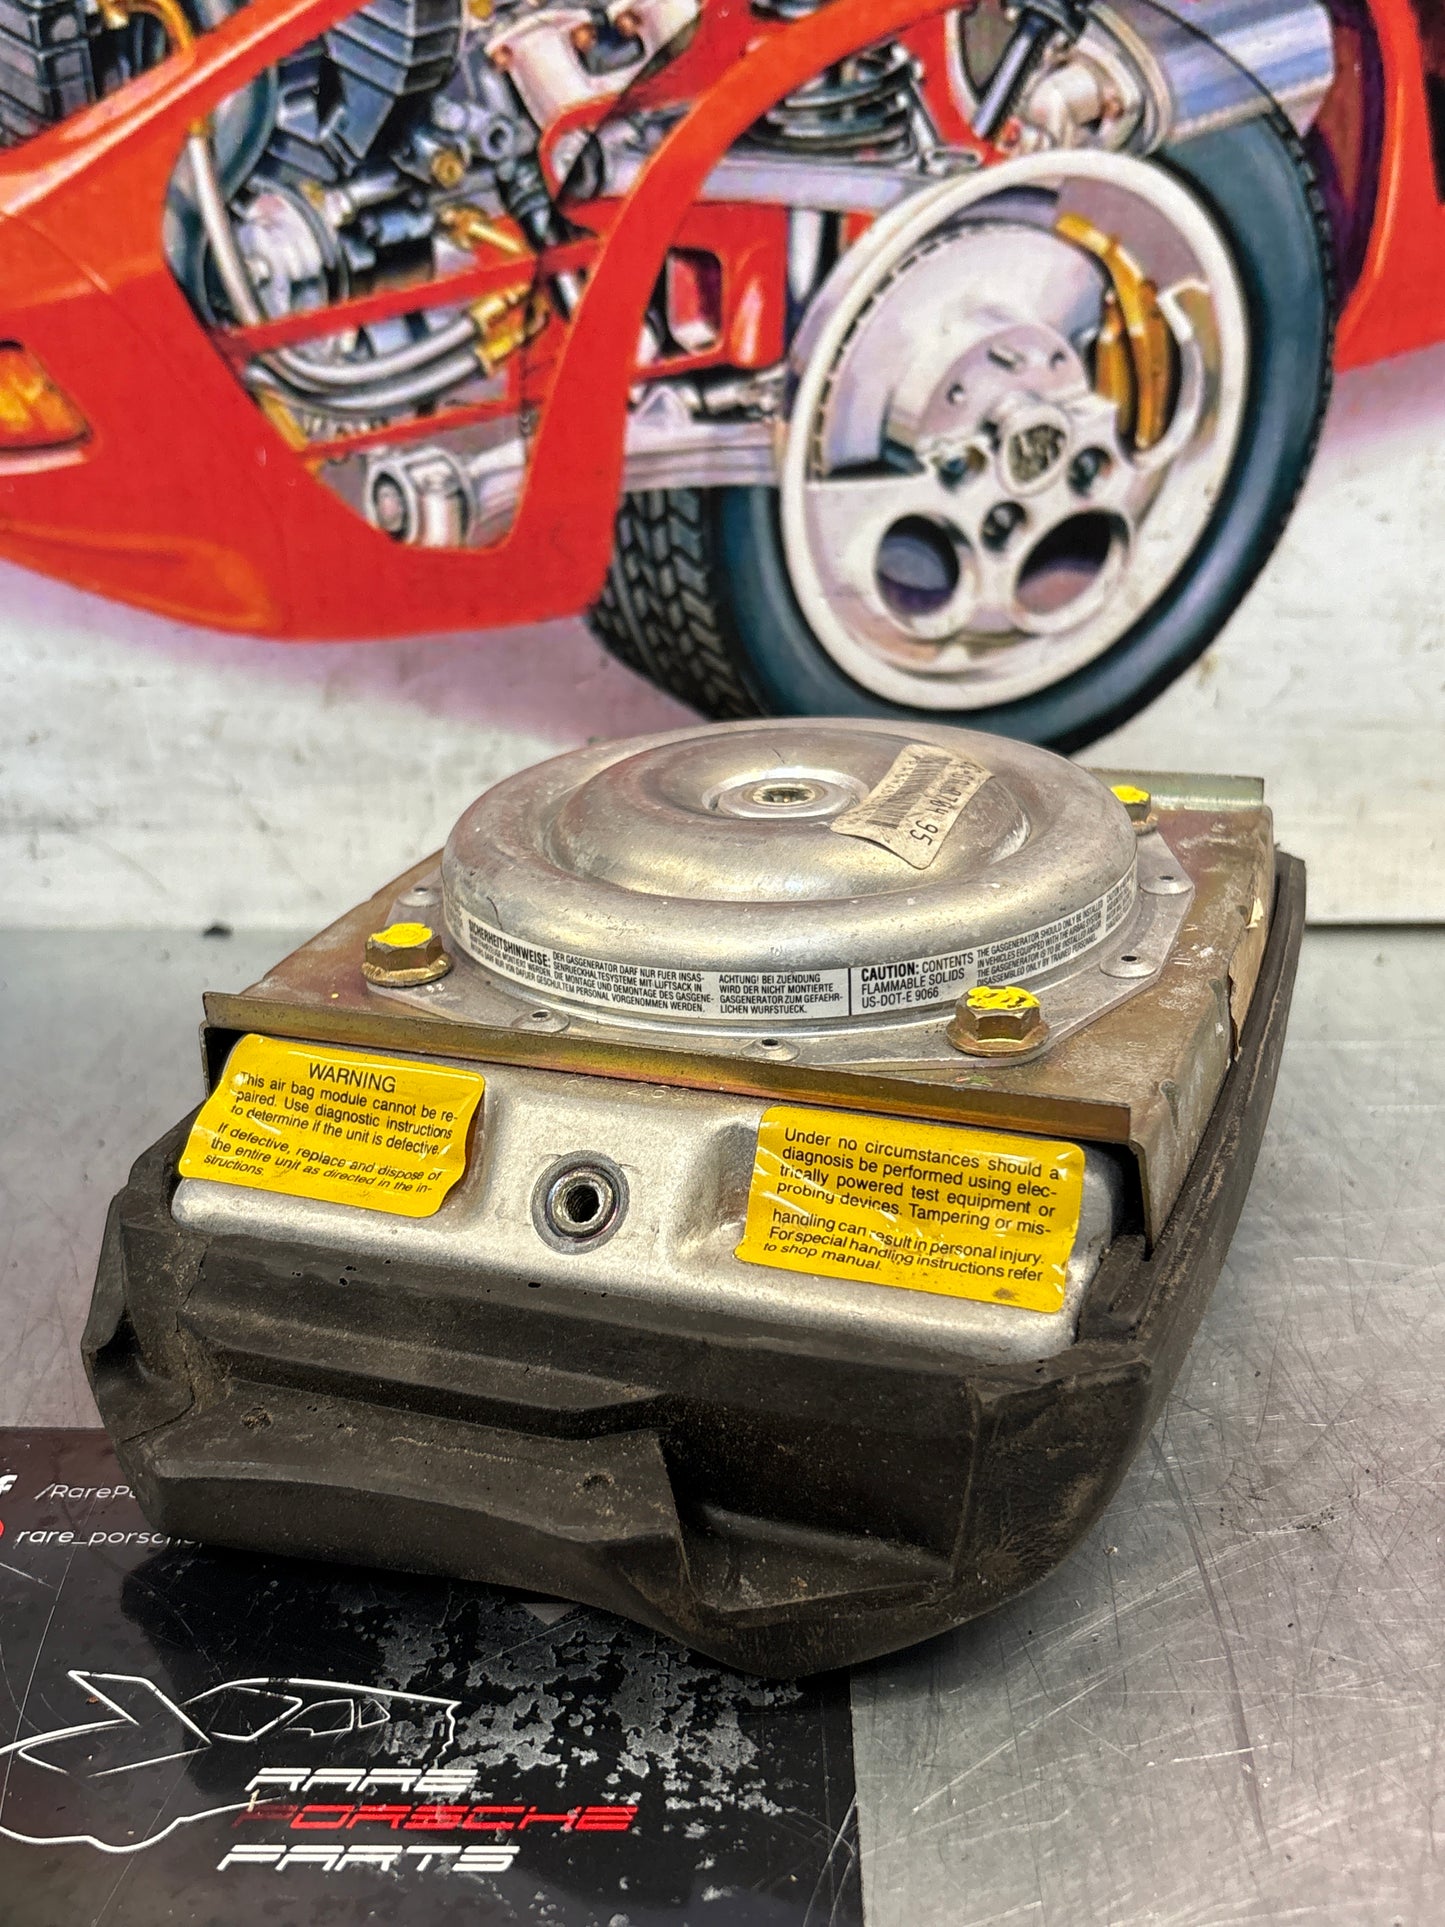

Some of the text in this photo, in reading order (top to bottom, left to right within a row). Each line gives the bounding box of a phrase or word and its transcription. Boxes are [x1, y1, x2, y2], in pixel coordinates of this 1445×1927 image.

[910, 820, 939, 846] 95
[977, 948, 990, 958] THE
[991, 932, 1039, 955] GASGENERATOR
[1040, 922, 1061, 938] SHOULD
[977, 959, 984, 968] IN
[985, 951, 1015, 966] VEHICLES
[1016, 940, 1044, 958] EQUIPPED
[553, 952, 564, 961] DER
[566, 955, 618, 973] GASGENERATOR
[620, 965, 638, 976] DARF
[640, 969, 656, 978] NUR
[658, 970, 676, 980] FUER
[679, 973, 704, 982] INSAS-
[553, 961, 702, 992] SENRUECKHALTESYSTEME MIT LUFTSACK IN
[862, 952, 974, 982] CAUTION: CONTENTS
[977, 967, 990, 978] THE
[991, 952, 1039, 975] GASGENERATOR
[1040, 950, 1046, 958] IS
[1047, 946, 1054, 955] TO
[977, 967, 1025, 986] DISASSEMBLED
[1026, 960, 1041, 973] ONLY
[536, 975, 575, 993] GESCHULTEM
[576, 986, 609, 1000] PERSONAL
[611, 993, 668, 1009] VORGENOMMEN
[671, 1001, 705, 1013] WERDEN.
[554, 971, 564, 980] DIE
[565, 974, 595, 989] MONTAGE
[597, 981, 612, 992] UND
[614, 984, 656, 998] DEMONTAGE
[659, 990, 674, 999] DES
[676, 992, 714, 1003] GASGENE-
[719, 974, 820, 984] ACHTUNG! BEI ZUENDUNG
[720, 983, 833, 994] WIRD DER NICHT MONTIERTE
[862, 968, 965, 995] FLAMMABLE SOLIDS
[720, 993, 843, 1004] GASGENERATOR ZUM GEFAEHR-
[721, 1005, 807, 1014] LICHEN WURFSTUECK.
[862, 986, 939, 1009] US-DOT-E 9066
[309, 1062, 397, 1093] WARNING
[240, 1071, 458, 1122] This air bag module cannot be re-
[231, 1104, 440, 1155] to determine if the unit is defective.
[236, 1090, 453, 1140] paired. Use diagnostic instructions
[204, 1153, 264, 1176] structions.
[211, 1137, 432, 1193] the entire unit as directed in the in-
[218, 1122, 442, 1181] If defective, replace and dispose of
[784, 1127, 1059, 1180] Under no circumstances should a
[782, 1146, 1057, 1197] diagnosis be performed using elec-
[780, 1164, 1055, 1217] trically powered test equipment or
[777, 1182, 1051, 1235] probing devices. Tampering or mis-
[772, 1208, 1044, 1265] handling can result in personal injury.
[763, 1242, 882, 1271] to shop manual.
[769, 1226, 1043, 1281] For special handling instructions refer
[244, 1767, 479, 1794] RARE
[231, 1803, 640, 1831] PORSCHE
[215, 1843, 521, 1873] PARTS
